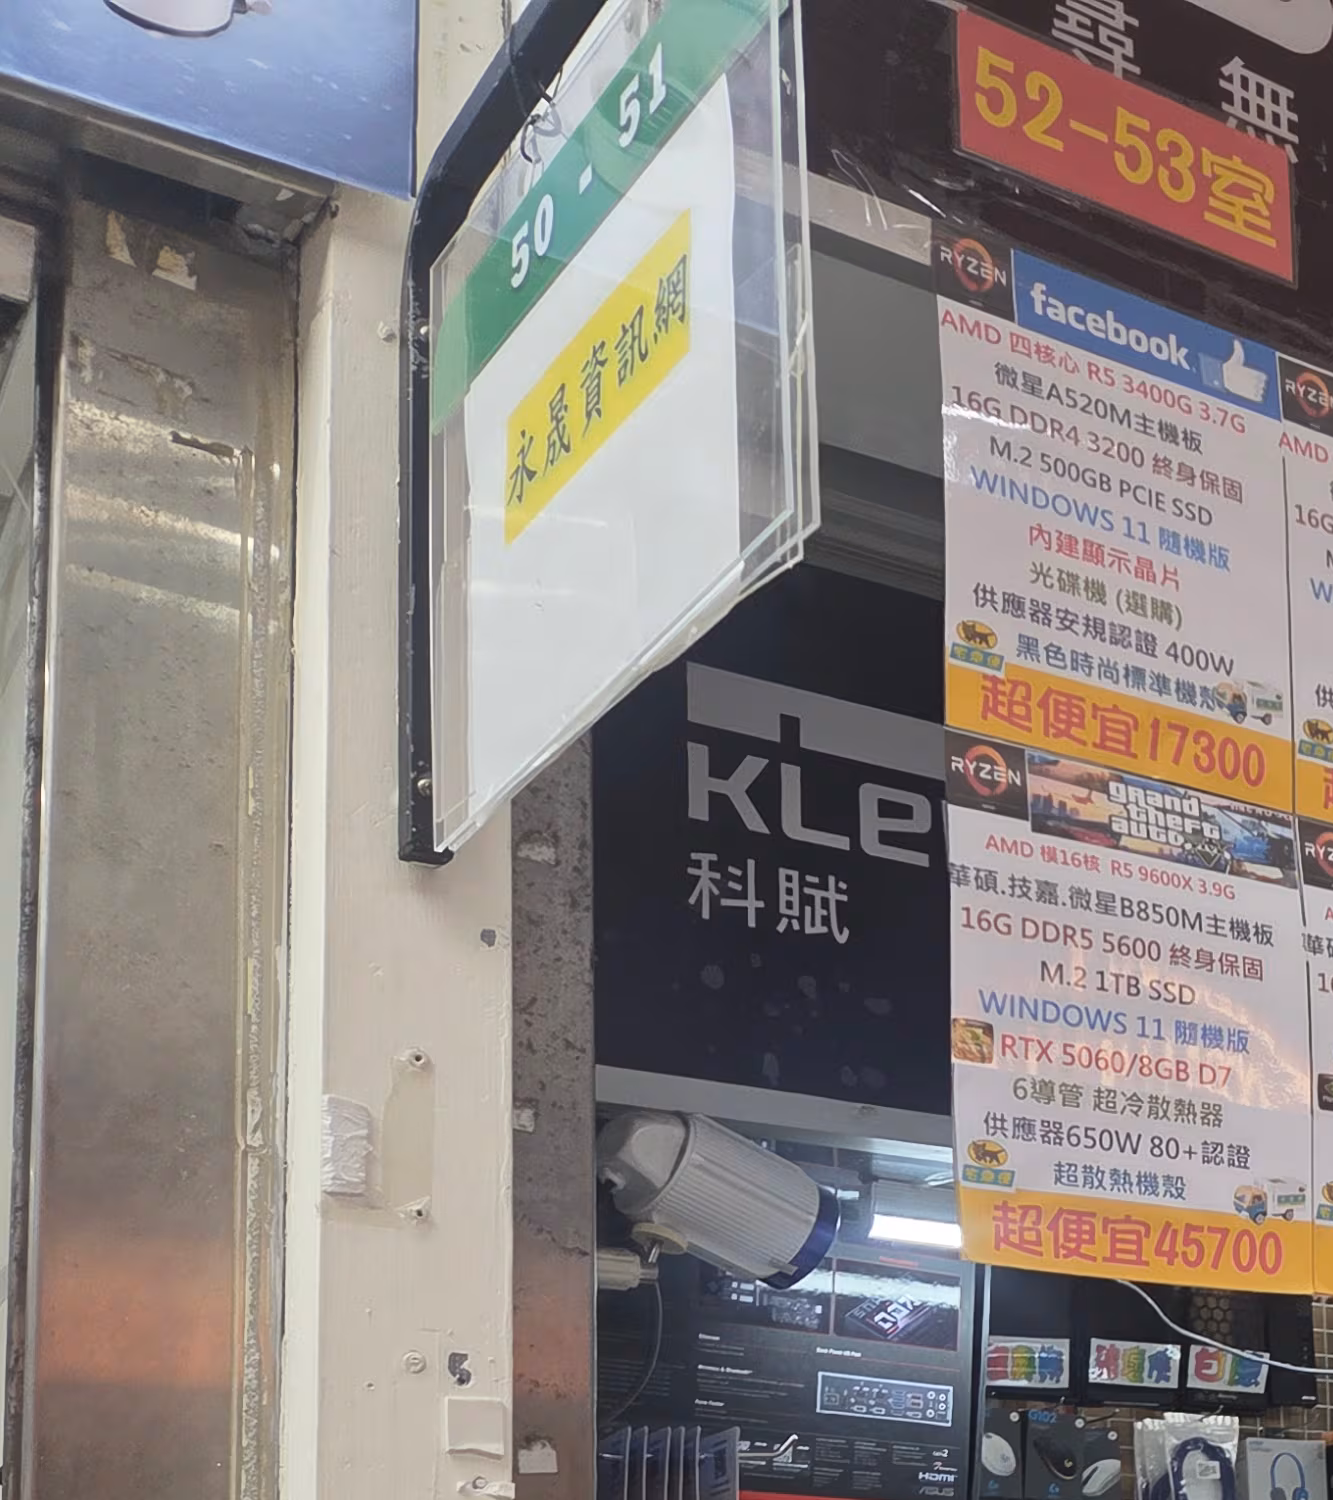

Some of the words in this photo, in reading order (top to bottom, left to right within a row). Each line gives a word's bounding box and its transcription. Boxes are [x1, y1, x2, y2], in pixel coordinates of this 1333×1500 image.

[510, 192, 555, 290] 50
[617, 43, 664, 149] 51
[972, 46, 1278, 251] 52-53室
[939, 245, 1006, 287] RYZEN
[941, 309, 1001, 347] AMD
[1011, 330, 1079, 375] 四核心
[1088, 356, 1117, 383] R5
[1123, 373, 1193, 417] 3400G
[1198, 398, 1246, 434] 3.7G
[1030, 282, 1190, 371] facebook
[506, 253, 689, 506] 永晟資訊網
[994, 361, 1203, 455] 微星A520M主機板
[950, 385, 1001, 419] 16G
[1009, 407, 1080, 446] DDR4
[1087, 431, 1145, 469] 3200
[1153, 453, 1243, 504] 終身保固
[989, 436, 1032, 467] M.2
[1039, 454, 1111, 494] 500GB
[1120, 478, 1166, 509] PCIE
[1172, 495, 1213, 526] SSD
[1279, 433, 1329, 464] AMD
[971, 466, 1114, 531] WINDOWS
[1121, 515, 1150, 544] 11
[1158, 527, 1231, 573] 隨機版
[1028, 523, 1182, 591] 內建顯示晶片
[972, 581, 1157, 659] 供應器安規認證
[1165, 640, 1235, 677] 400W
[951, 756, 1021, 787] RYZEN
[981, 673, 1265, 788] 超便宜17300
[687, 852, 849, 944] 科賦
[960, 907, 1013, 936] 16G
[1021, 918, 1094, 949] DDR5
[1101, 932, 1161, 962] 5600
[1169, 943, 1264, 981] 終身保固
[1040, 961, 1085, 988] M.2
[1095, 971, 1141, 997] 1TB
[1148, 978, 1195, 1005] SSD
[978, 990, 1128, 1036] WINDOWS
[1137, 1015, 1163, 1041] 11
[1174, 1021, 1250, 1055] 隨機版
[1001, 1034, 1054, 1063] RTX
[1061, 1046, 1190, 1082] 5060/8GB
[1198, 1062, 1232, 1088] D7
[992, 1201, 1283, 1276] 超便宜45700
